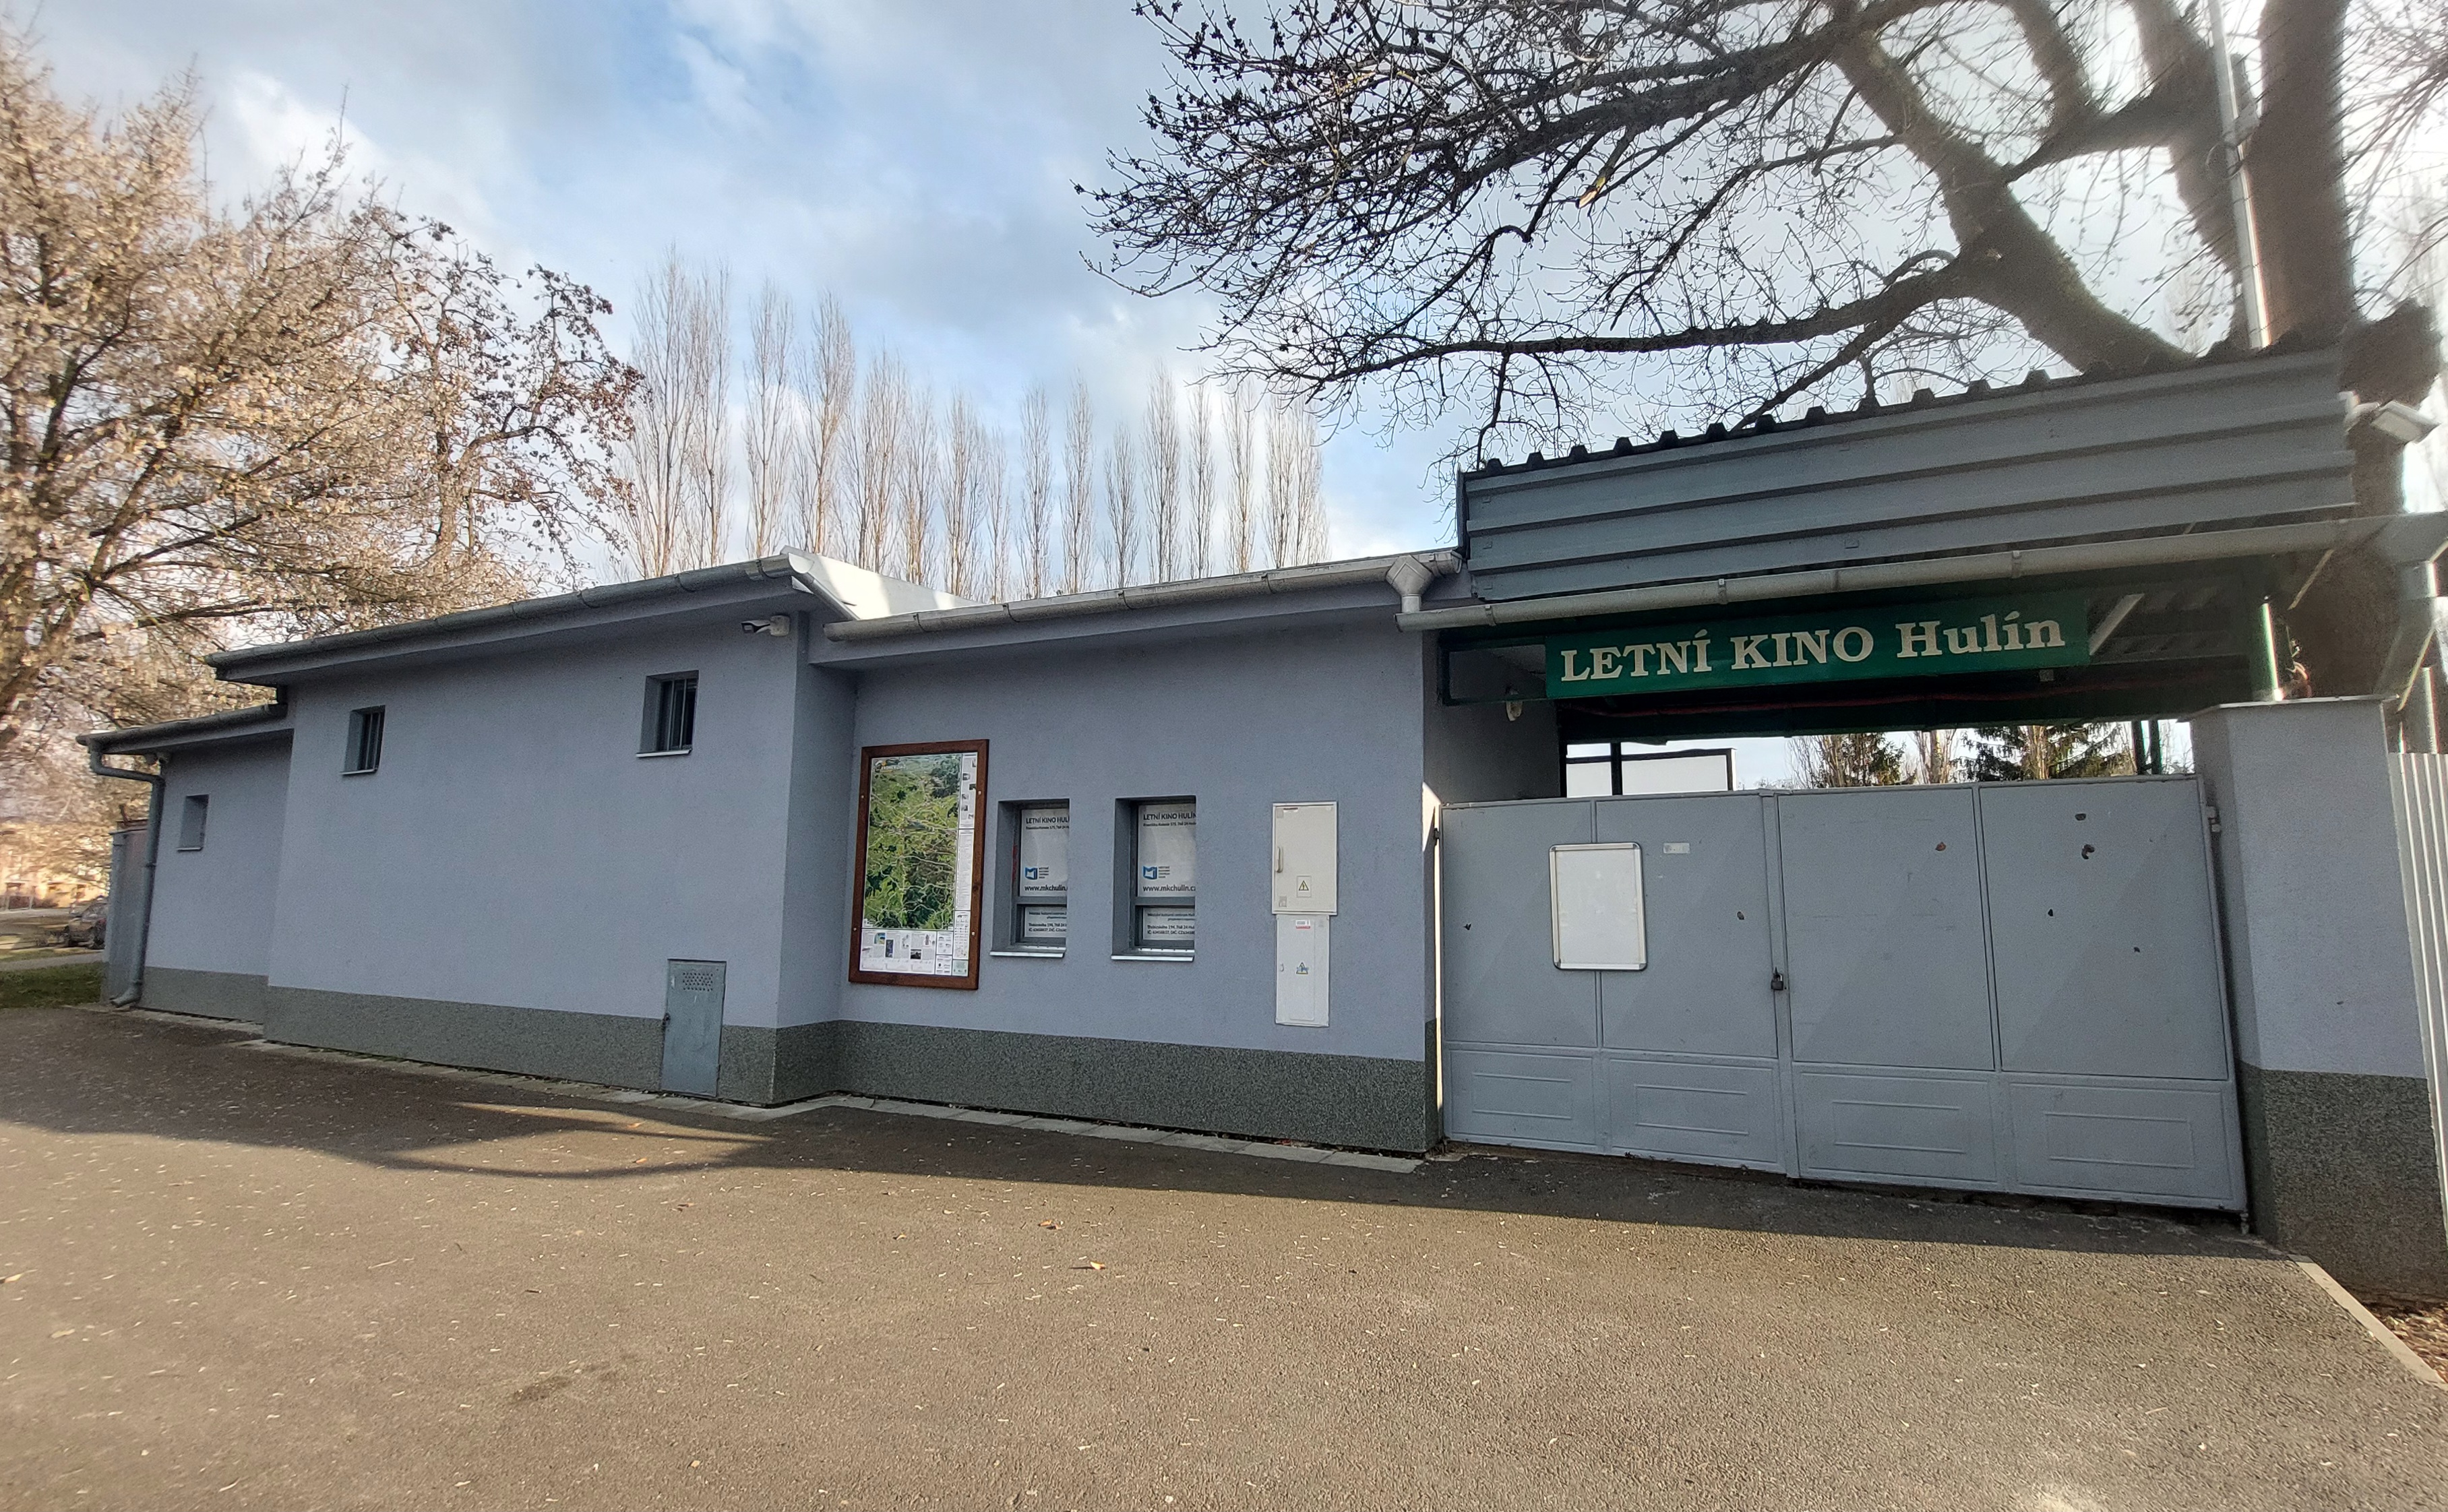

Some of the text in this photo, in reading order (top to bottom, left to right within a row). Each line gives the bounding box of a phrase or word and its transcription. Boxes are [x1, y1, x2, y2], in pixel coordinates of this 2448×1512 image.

[1560, 610, 2066, 683] LETNÍ KINO Hulín
[1143, 812, 1160, 821] LETNÍ
